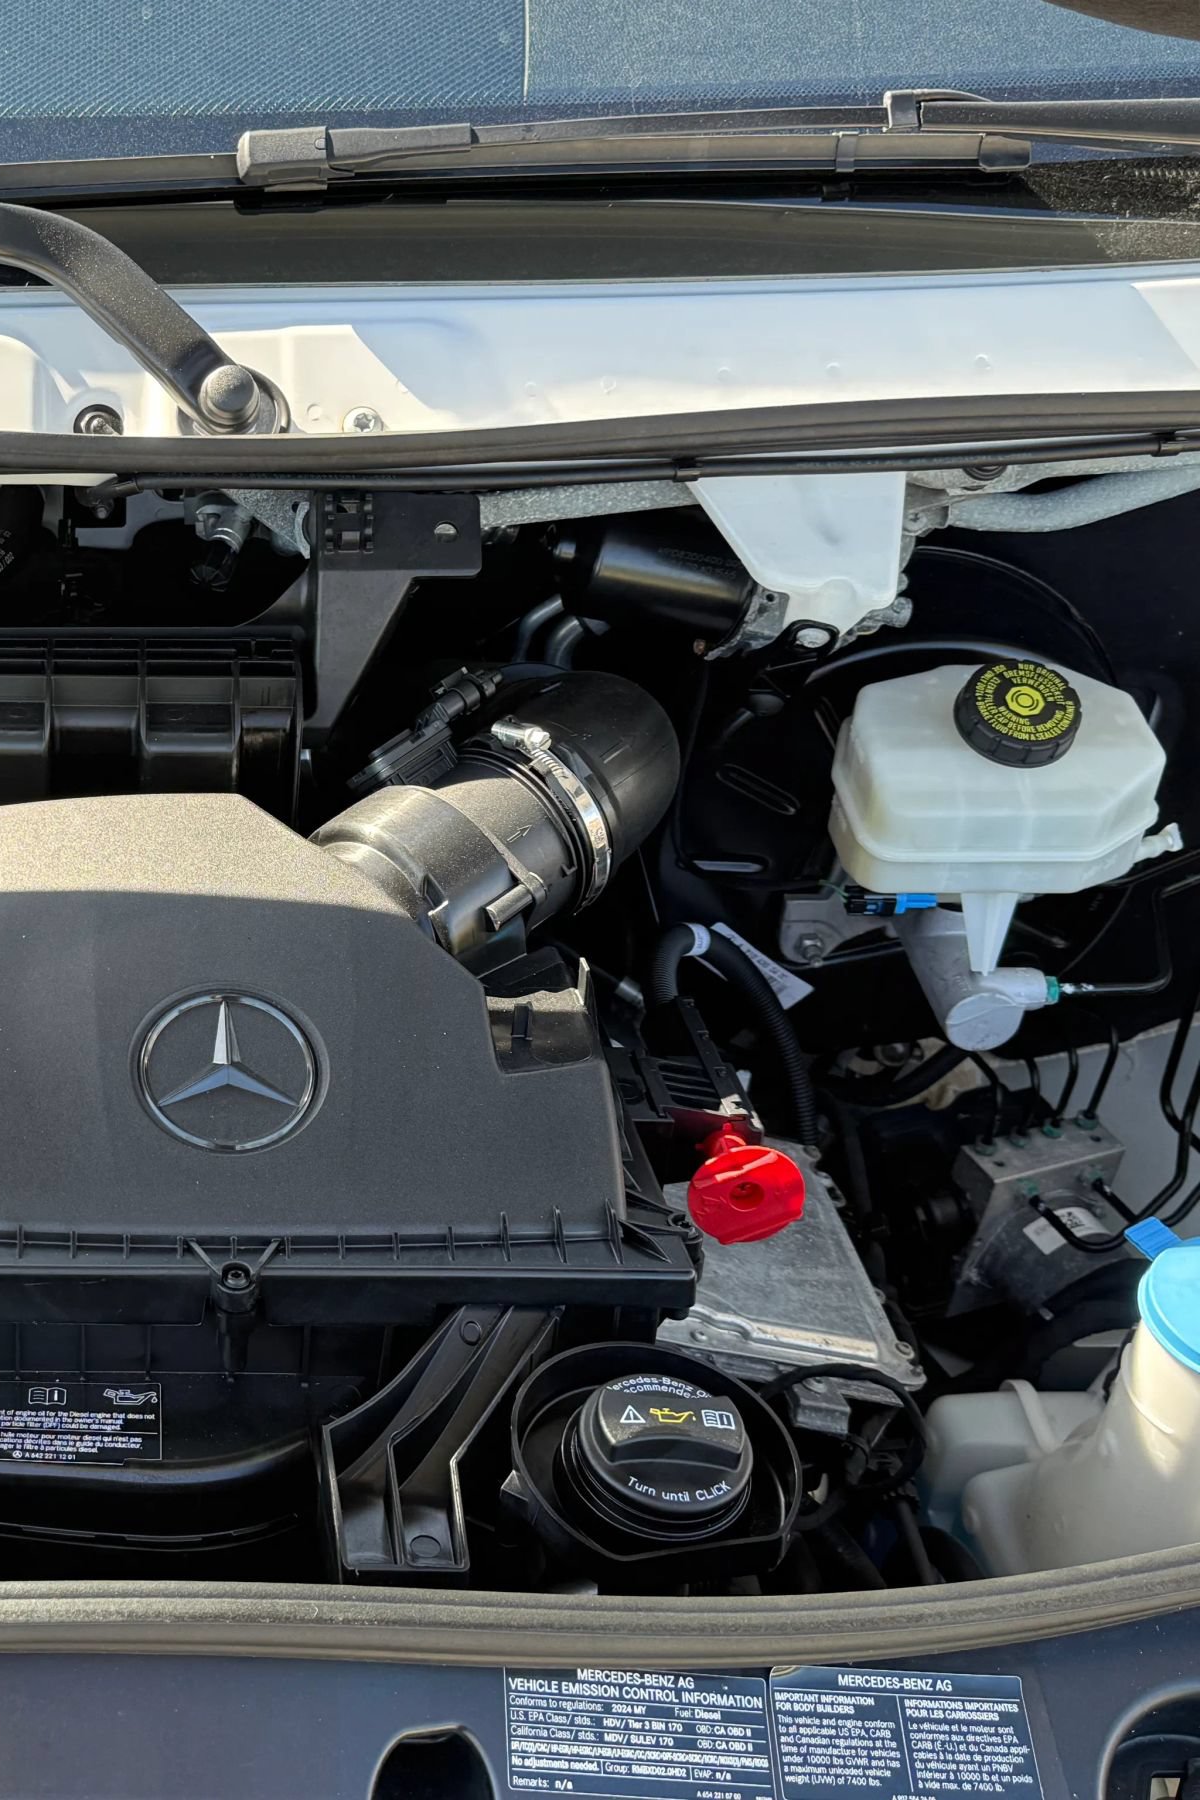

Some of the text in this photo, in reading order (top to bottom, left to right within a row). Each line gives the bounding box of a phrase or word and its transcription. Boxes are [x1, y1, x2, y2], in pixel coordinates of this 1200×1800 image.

[1036, 667, 1066, 690] ORIGINAL
[1011, 678, 1055, 701] VERWENDEN
[999, 706, 1029, 725] WARNING
[988, 718, 1008, 733] FLUID
[1008, 731, 1029, 740] FROM
[1036, 728, 1061, 740] SEALED
[994, 714, 1008, 724] CAP
[1008, 722, 1036, 733] BEFORE
[628, 1476, 731, 1502] Turn until CLICK
[576, 1668, 694, 1689] MERCEDES-BENZ AG
[838, 1674, 952, 1691] MERCEDES-BENZ AG
[508, 1677, 763, 1709] VEHICLE EMISSION CONTROL INFORMATION
[774, 1692, 875, 1706] IMPORTANT INFORMATION
[509, 1695, 721, 1720] Conforms to regulations: 2024 MY Fuel: Diesel
[775, 1702, 855, 1714] FOR BODY BUILDERS
[904, 1699, 1019, 1712] INFORMATIONS IMPORTANTES
[777, 1714, 895, 1728] This vehicle and engine conform
[906, 1709, 1000, 1721] POUR LES CARROSSIERS
[510, 1711, 527, 1721] U.S.
[528, 1712, 544, 1722] EPA
[546, 1713, 572, 1725] Class/
[603, 1717, 626, 1729] HDV/
[628, 1719, 642, 1729] Tier
[644, 1720, 650, 1730] 3
[651, 1721, 666, 1731] BIN
[668, 1722, 683, 1732] 170
[727, 1726, 745, 1736] OBD
[779, 1724, 892, 1738] to all applicable US EPA, CARB
[908, 1722, 1014, 1734] Le véhicule et le moteur sont
[510, 1725, 548, 1737] California
[549, 1728, 575, 1740] Class/
[604, 1732, 628, 1744] MDV/
[630, 1734, 656, 1745] SULEV
[658, 1736, 674, 1746] 170
[728, 1741, 746, 1751] OBD
[780, 1735, 897, 1748] and Canadian regulations at the
[781, 1744, 901, 1758] time of manufacture for vehicles
[511, 1756, 522, 1766] No
[524, 1757, 569, 1769] adjustments
[570, 1761, 600, 1771] needed.
[604, 1762, 630, 1775] Group:
[694, 1768, 714, 1778] EVAP:
[716, 1770, 732, 1780] n/a
[782, 1755, 900, 1768] under 10000 lbs GVWR and has
[790, 1765, 827, 1774] maximum
[828, 1766, 863, 1776] unloaded
[865, 1768, 891, 1777] vehicle
[512, 1775, 573, 1790] Remarks: n/a
[784, 1774, 882, 1786] weight (UVW) of 7400 lbs.
[962, 1782, 1005, 1791] de 7400 lb.
